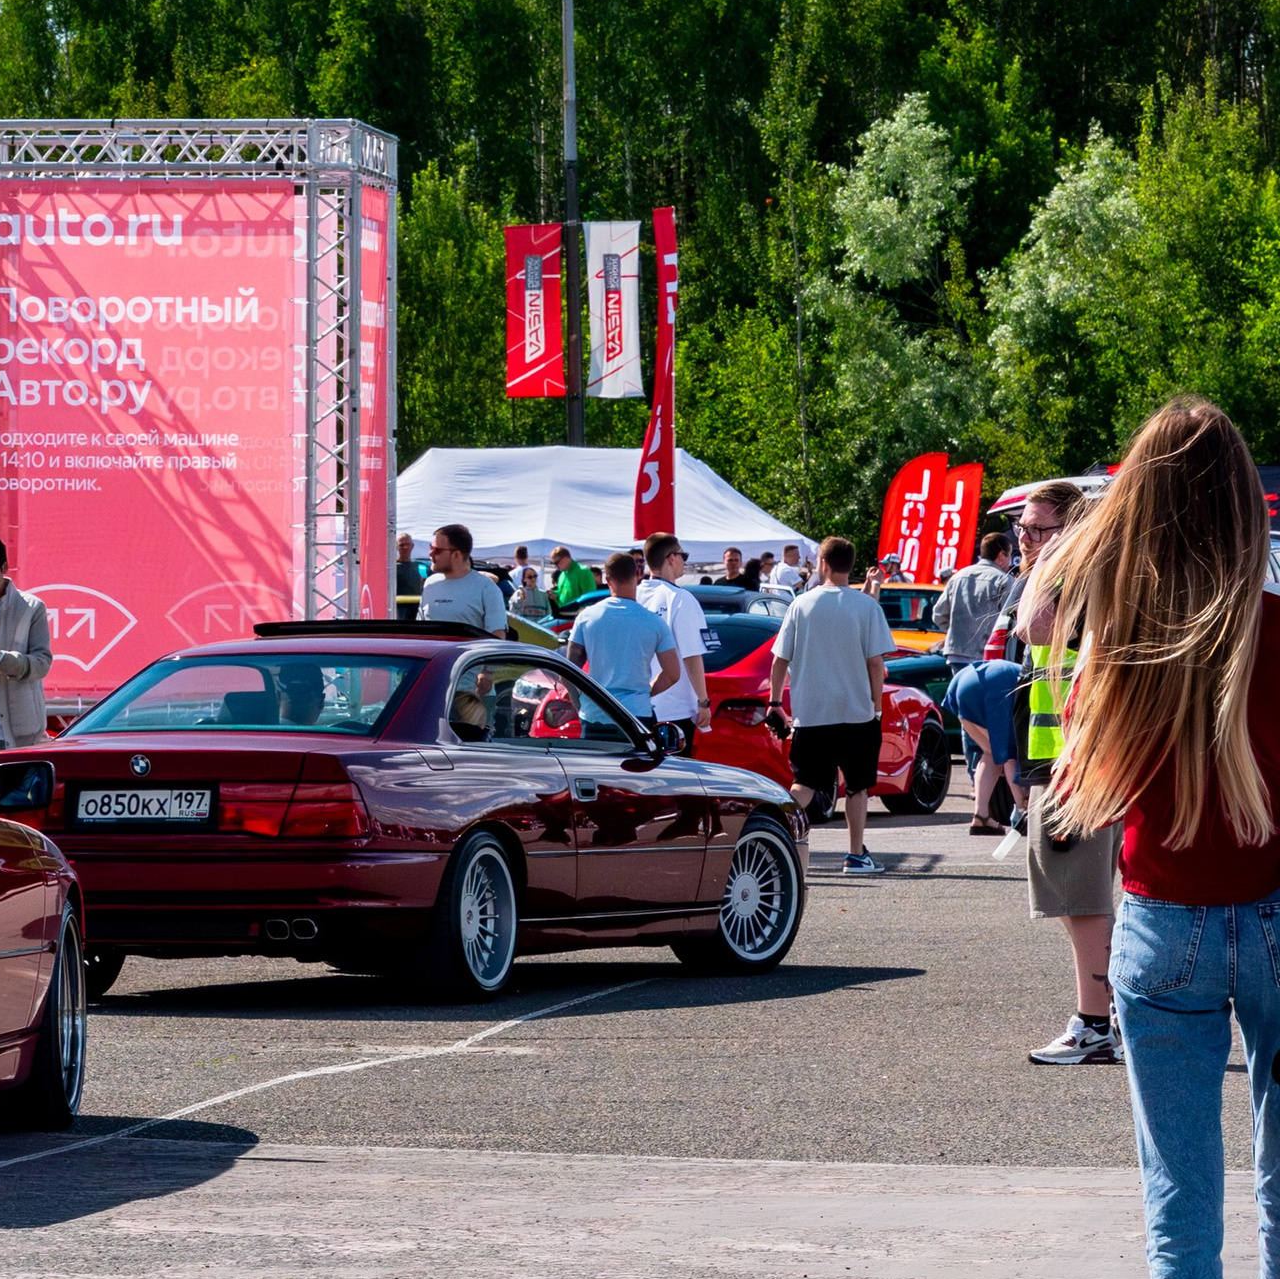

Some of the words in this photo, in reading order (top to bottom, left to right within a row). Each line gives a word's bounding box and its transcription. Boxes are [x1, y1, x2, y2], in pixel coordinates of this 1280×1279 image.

[91, 433, 101, 446] к
[105, 429, 159, 446] своей
[163, 433, 239, 447] машине
[0, 451, 45, 468] 14:10
[49, 456, 60, 468] и
[65, 452, 164, 469] включайте
[167, 452, 237, 472] правый
[174, 792, 206, 810] 197
